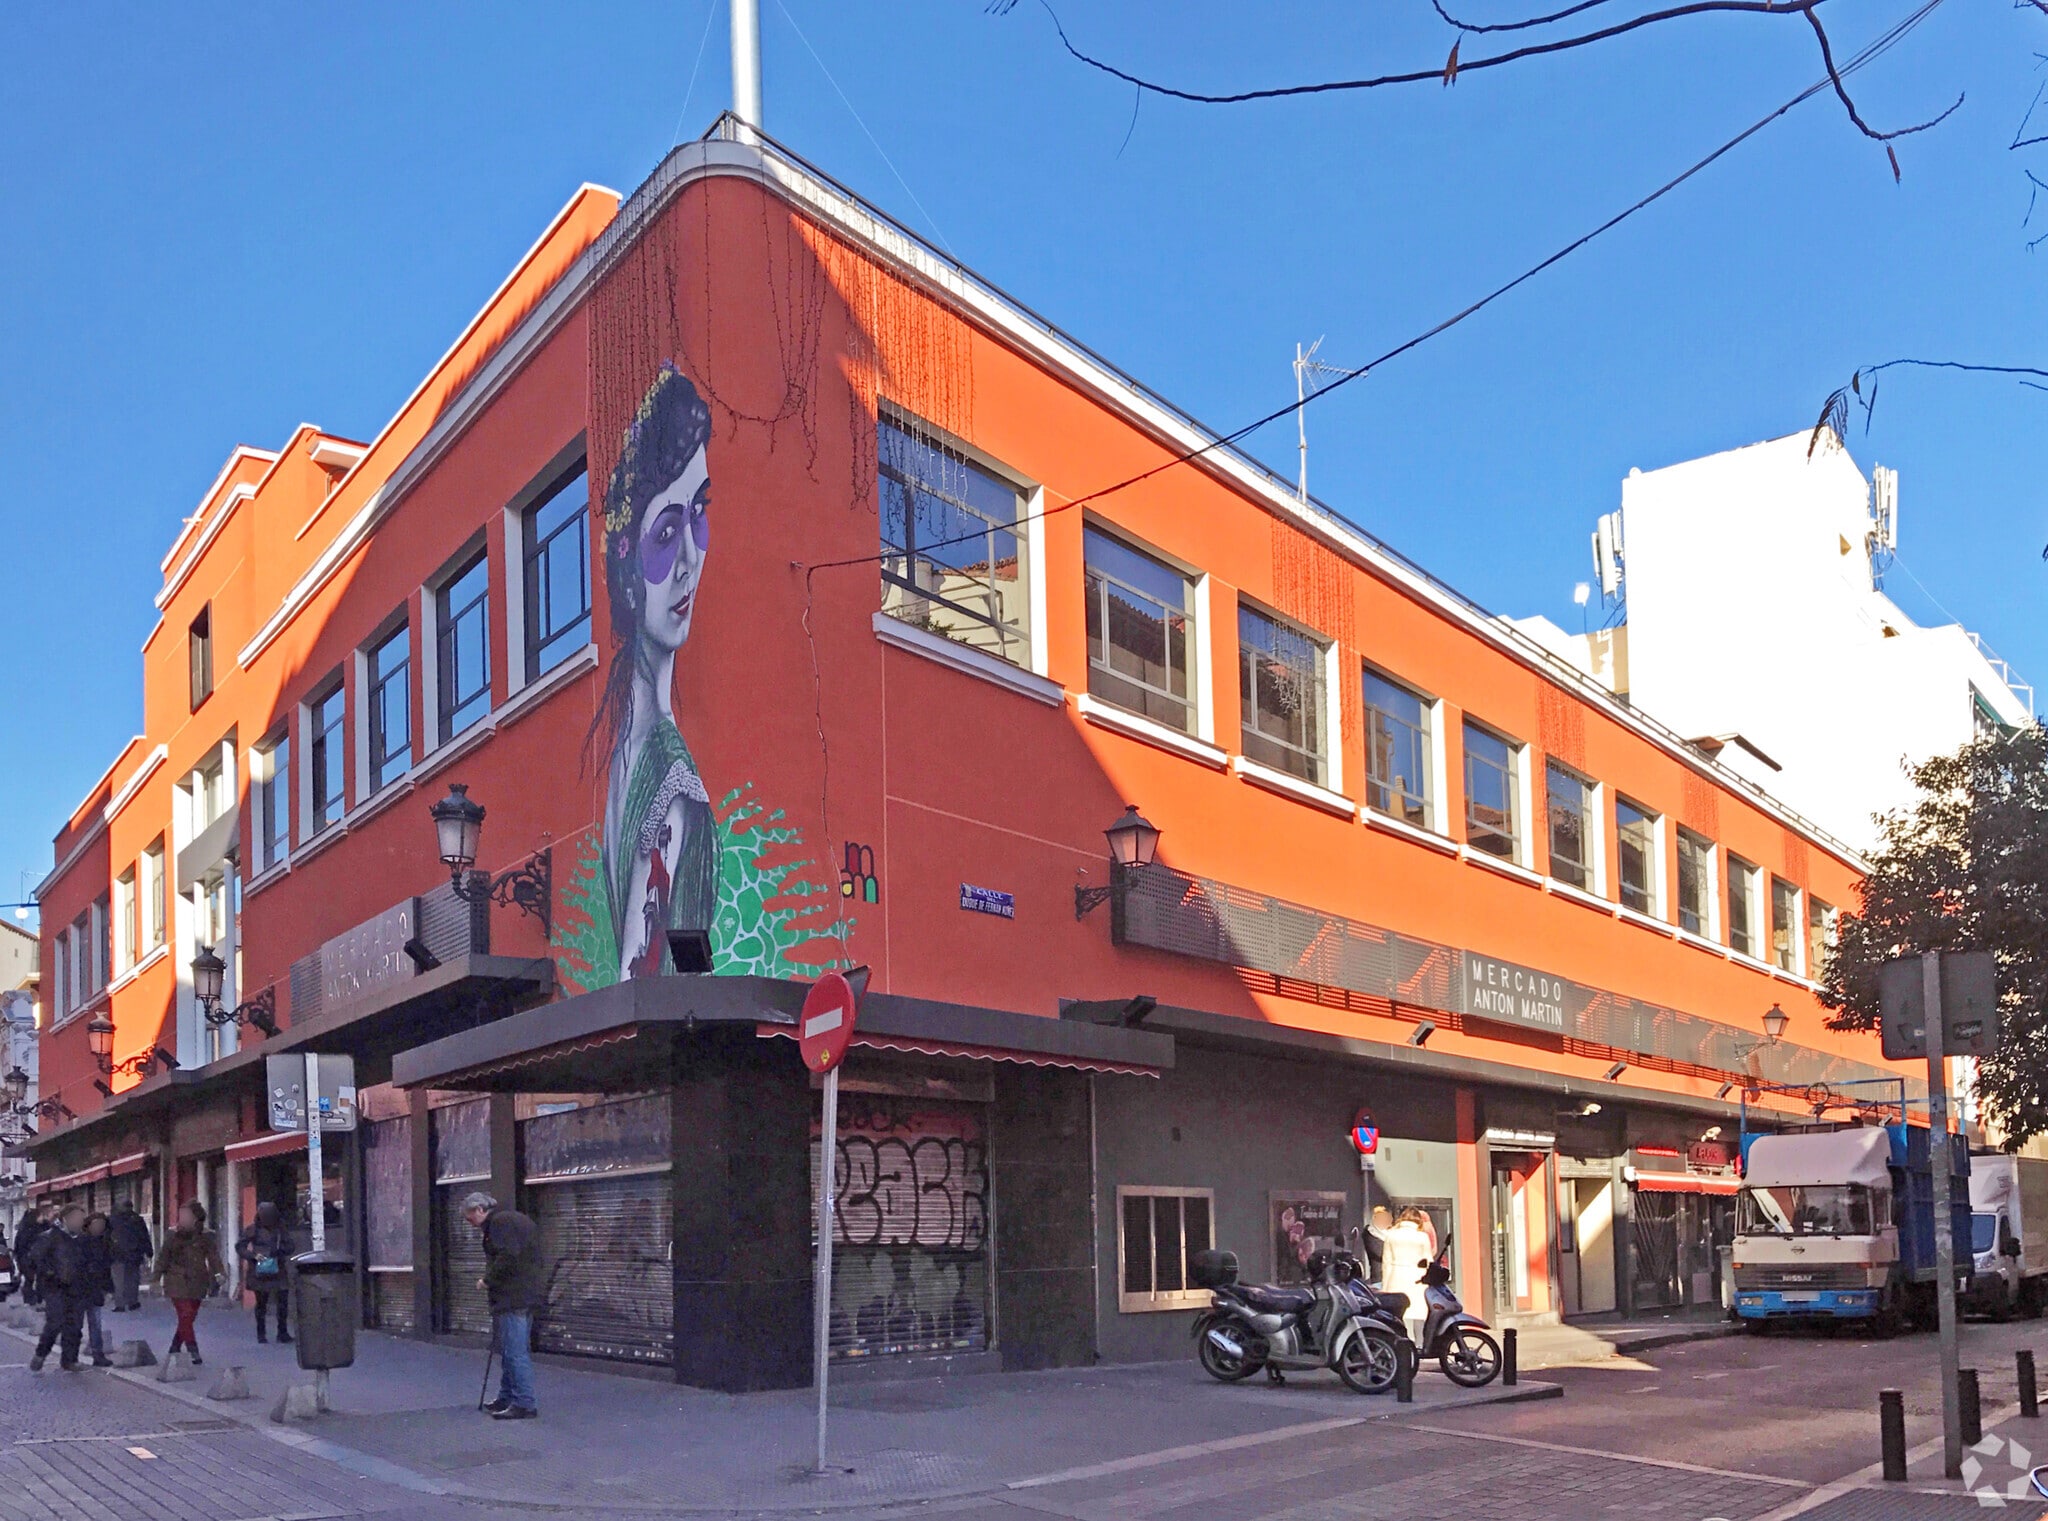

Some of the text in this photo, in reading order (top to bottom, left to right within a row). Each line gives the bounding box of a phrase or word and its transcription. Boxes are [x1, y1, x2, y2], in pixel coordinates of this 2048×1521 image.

[976, 888, 1003, 900] CALLE
[327, 911, 407, 971] MERCADO
[1472, 959, 1561, 1002] MERCADO
[1473, 987, 1563, 1026] ANTON MARTIN
